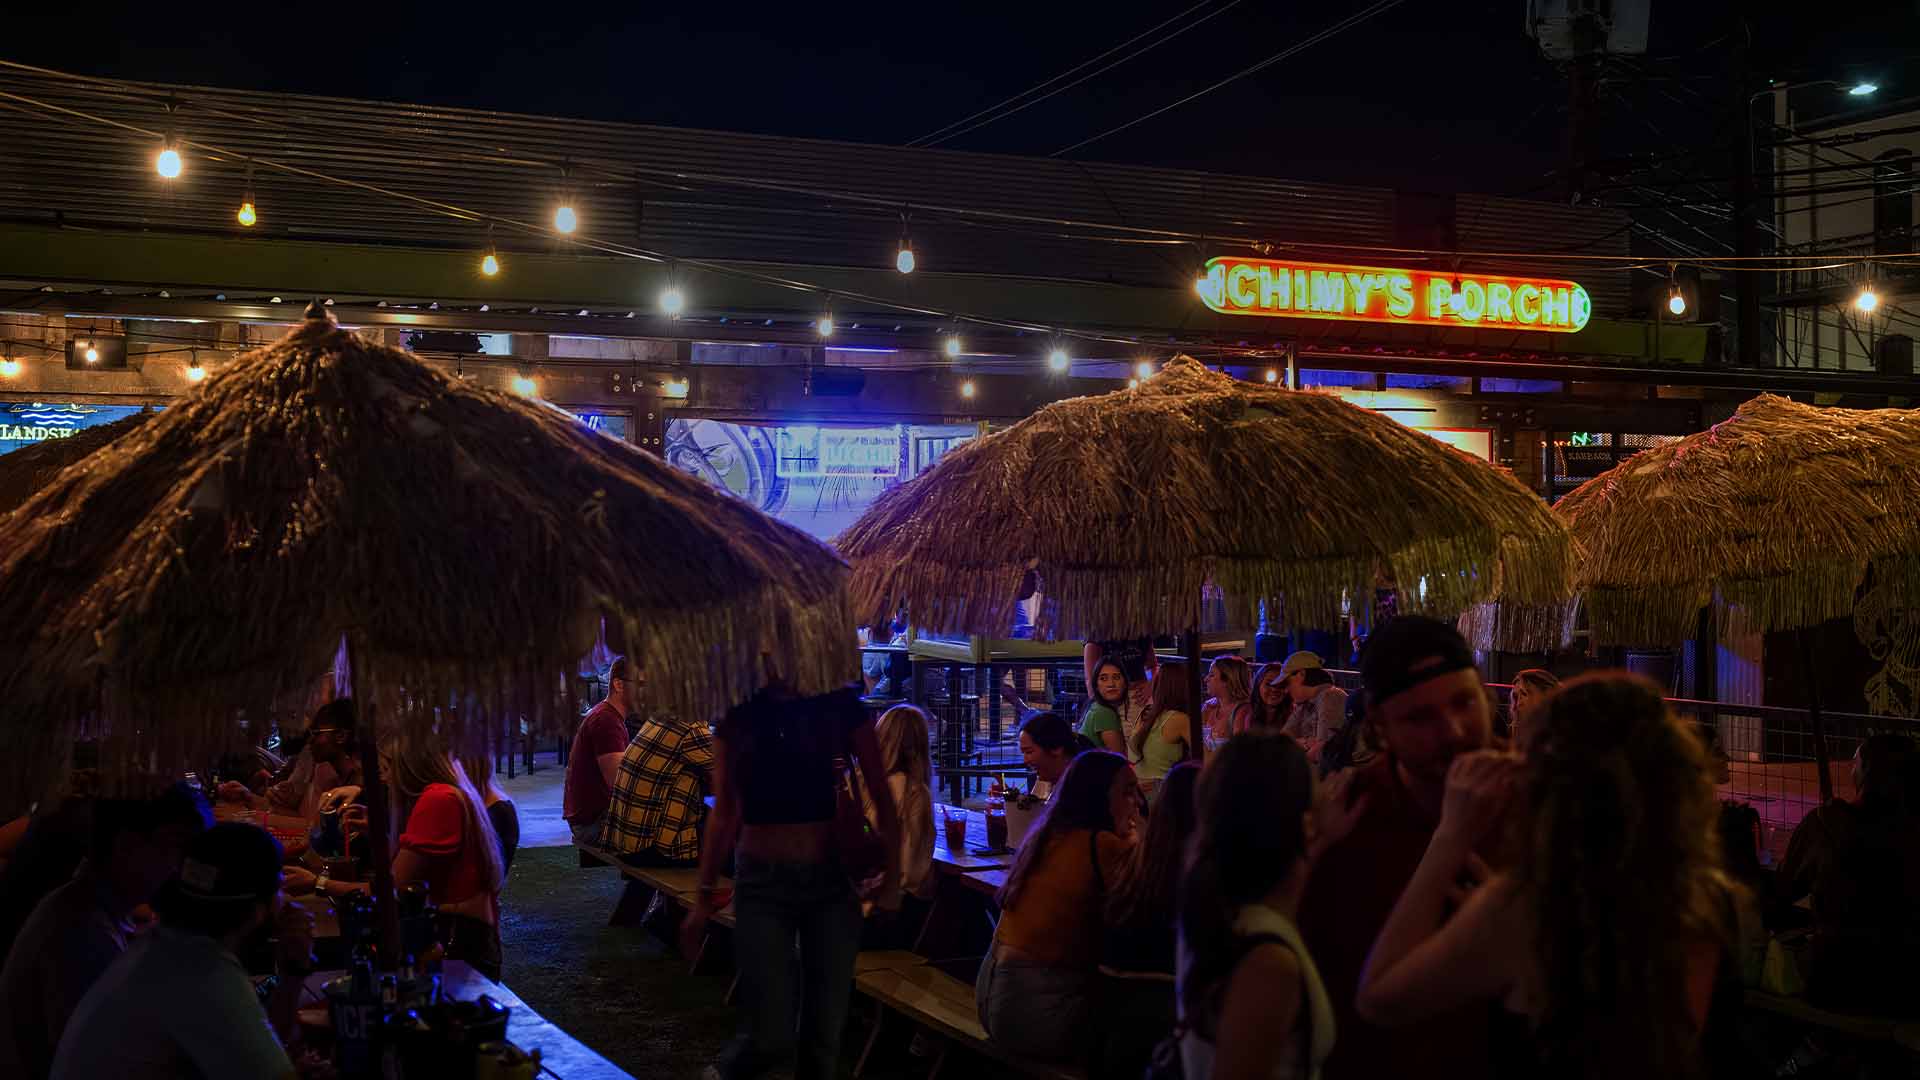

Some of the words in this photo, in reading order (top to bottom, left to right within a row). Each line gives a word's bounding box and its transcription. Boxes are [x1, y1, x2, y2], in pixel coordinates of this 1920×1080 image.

[1228, 264, 1414, 316] CHIMY'S
[1428, 278, 1569, 325] PORCH
[0, 423, 80, 441] LANDSH
